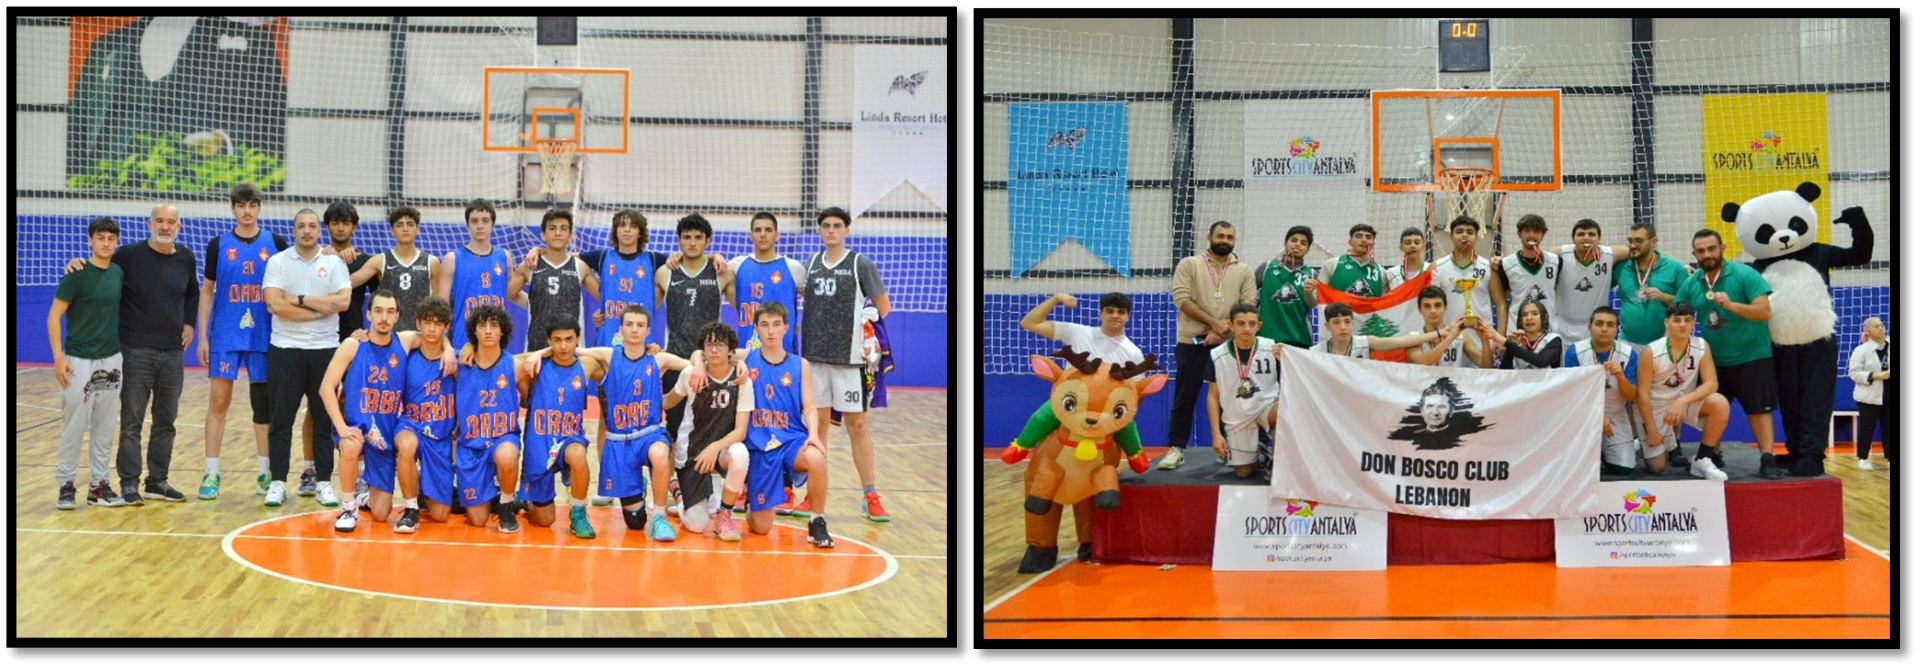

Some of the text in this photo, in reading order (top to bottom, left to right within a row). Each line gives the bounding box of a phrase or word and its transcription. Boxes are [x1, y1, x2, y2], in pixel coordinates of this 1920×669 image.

[860, 111, 890, 122] Linda
[893, 112, 926, 123] Resort
[242, 260, 255, 275] 31
[1366, 266, 1380, 281] 13
[1472, 267, 1486, 281] 39
[1545, 266, 1555, 280] 8
[1594, 262, 1608, 276] 34
[399, 272, 412, 290] 8
[480, 272, 492, 289] 8
[547, 276, 560, 295] 5
[618, 277, 634, 293] 91
[814, 277, 837, 296] 30
[685, 288, 698, 306] 7
[1444, 348, 1458, 362] 30
[1687, 355, 1696, 370] 1
[367, 365, 388, 384] 24
[1255, 358, 1272, 374] 11
[557, 387, 565, 405] 1
[632, 379, 642, 396] 3
[764, 383, 775, 400] 0
[479, 389, 498, 408] 22
[710, 389, 731, 409] 10
[844, 390, 860, 403] 30
[465, 411, 516, 440] ORBI
[1361, 451, 1510, 481] DON BOSCO CLUB
[605, 478, 613, 491] 3
[463, 488, 478, 500] 22
[1395, 484, 1471, 507] LEBANON
